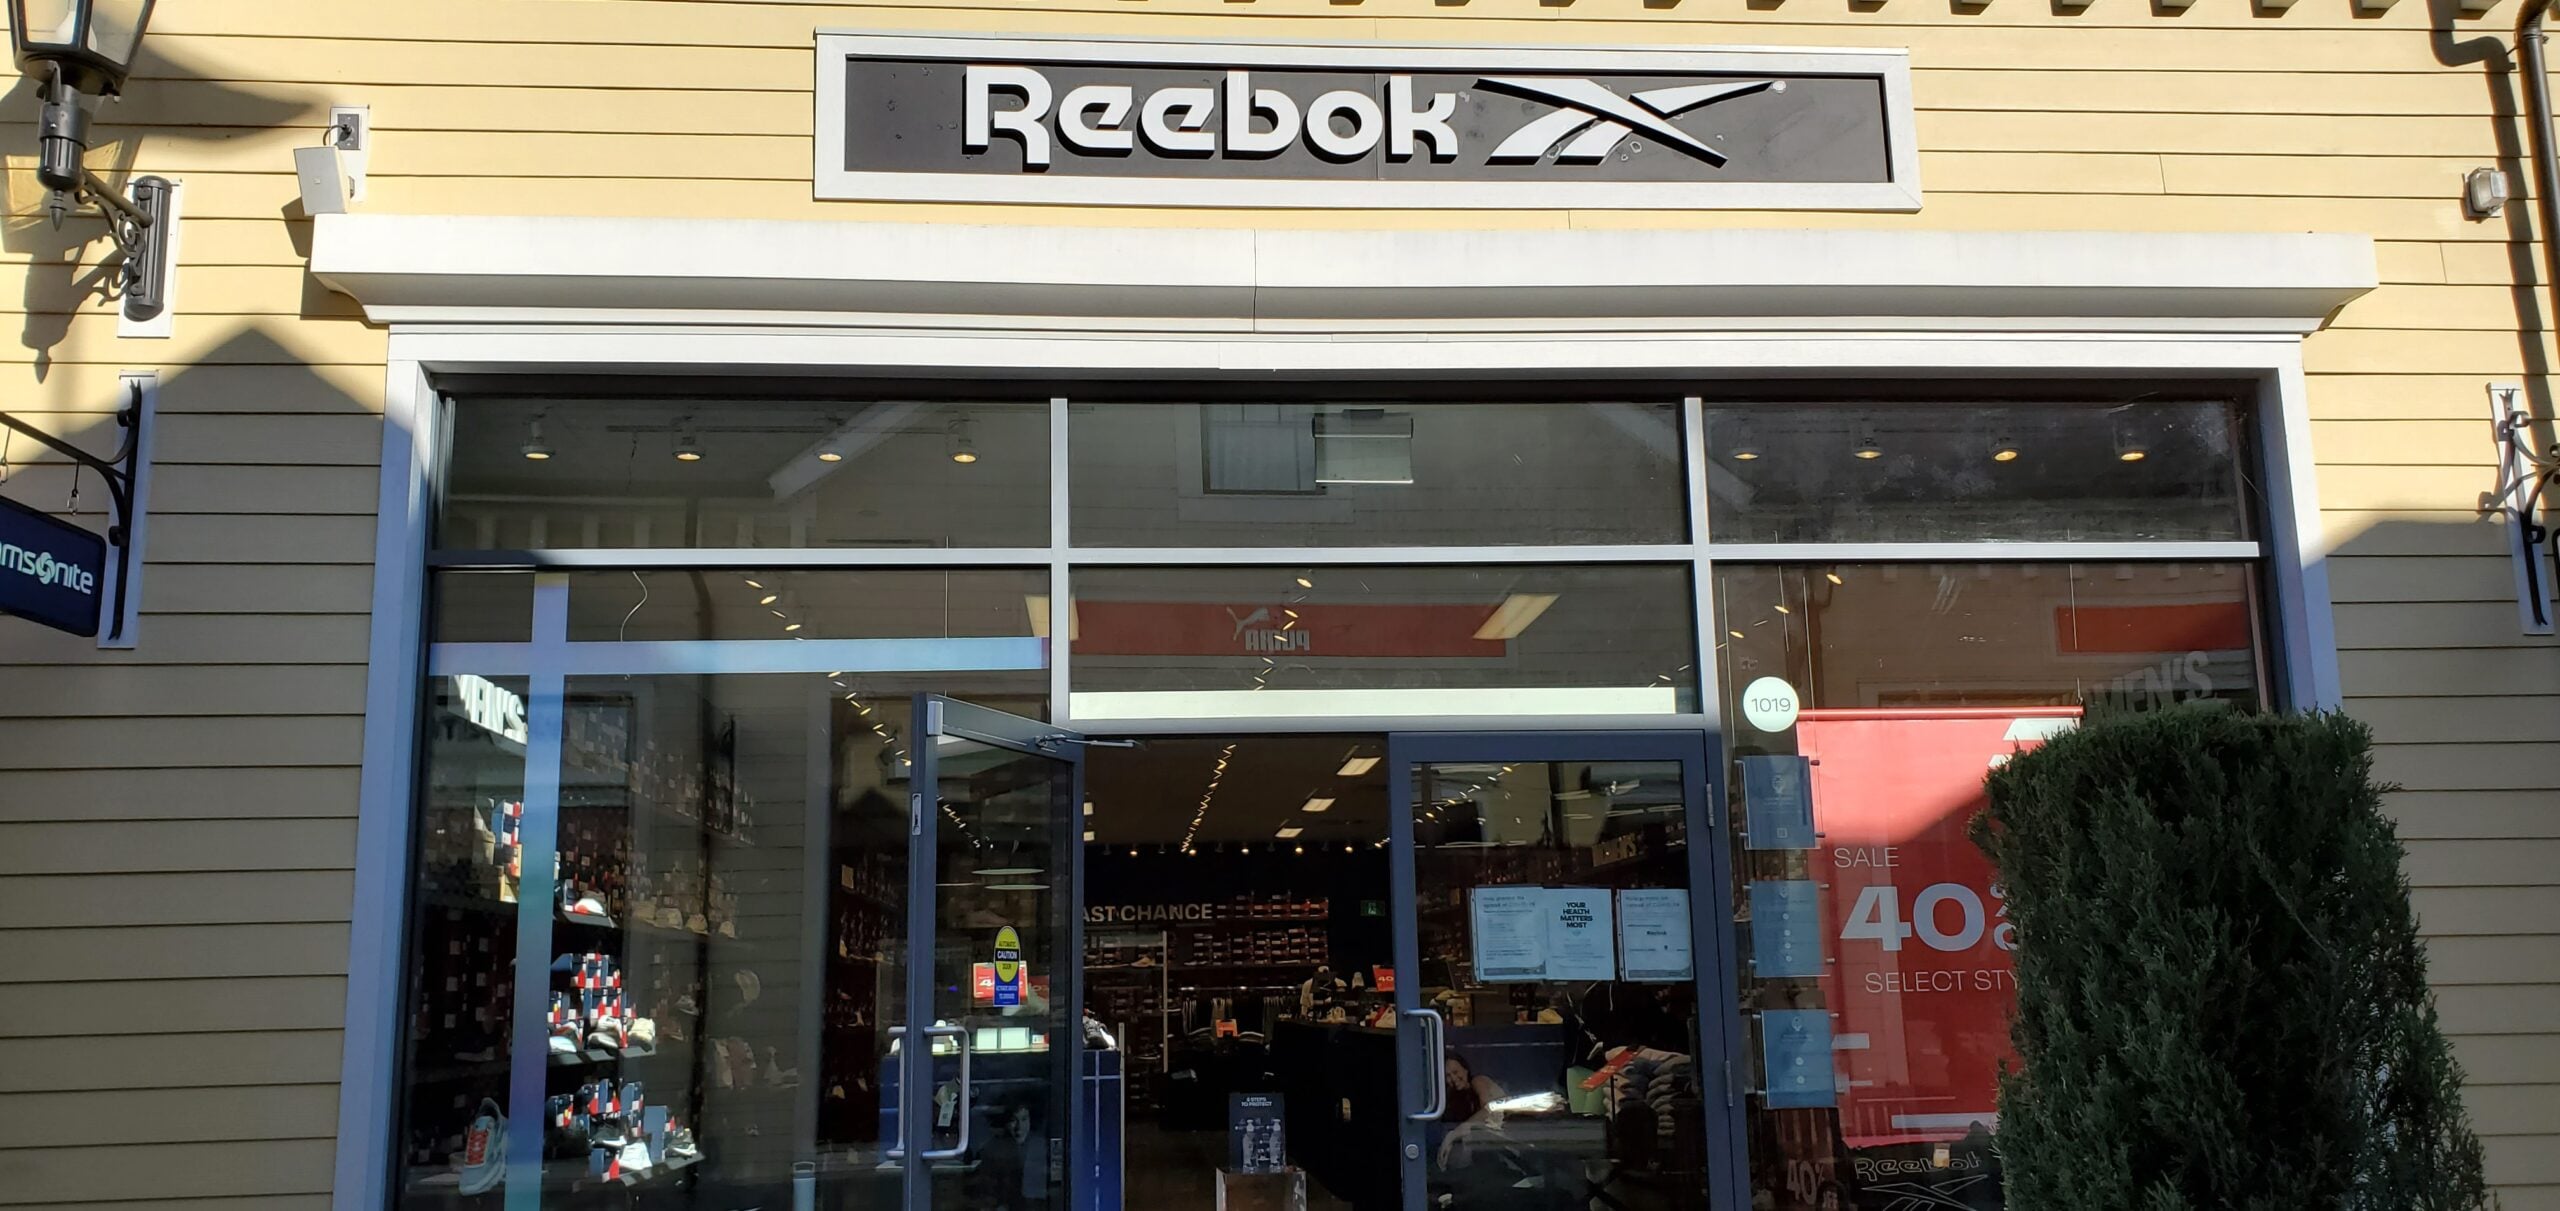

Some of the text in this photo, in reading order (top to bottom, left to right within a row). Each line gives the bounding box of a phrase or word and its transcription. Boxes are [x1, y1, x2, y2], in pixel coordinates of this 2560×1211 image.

[964, 65, 1459, 168] Reebok
[0, 541, 94, 595] msonite
[1751, 697, 1792, 713] 1019
[1833, 847, 1900, 868] SALE
[1120, 903, 1213, 921] CHANCE
[997, 951, 1018, 959] CAUTION
[1865, 969, 2021, 993] SELECT STY
